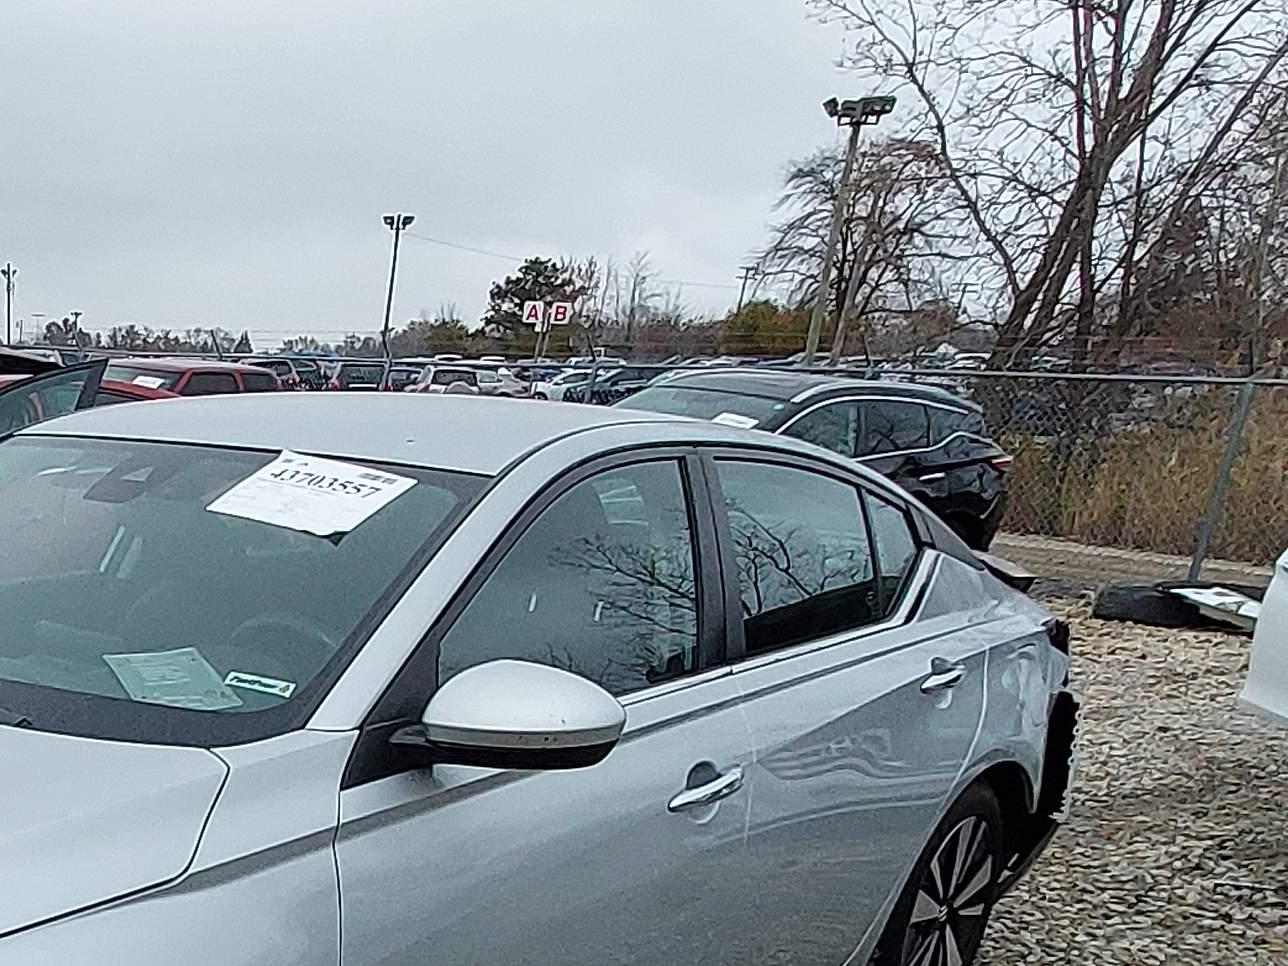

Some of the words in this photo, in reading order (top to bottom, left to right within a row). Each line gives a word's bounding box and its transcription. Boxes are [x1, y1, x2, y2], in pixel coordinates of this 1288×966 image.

[526, 304, 539, 321] A
[554, 305, 568, 321] B
[269, 468, 383, 498] 43703557
